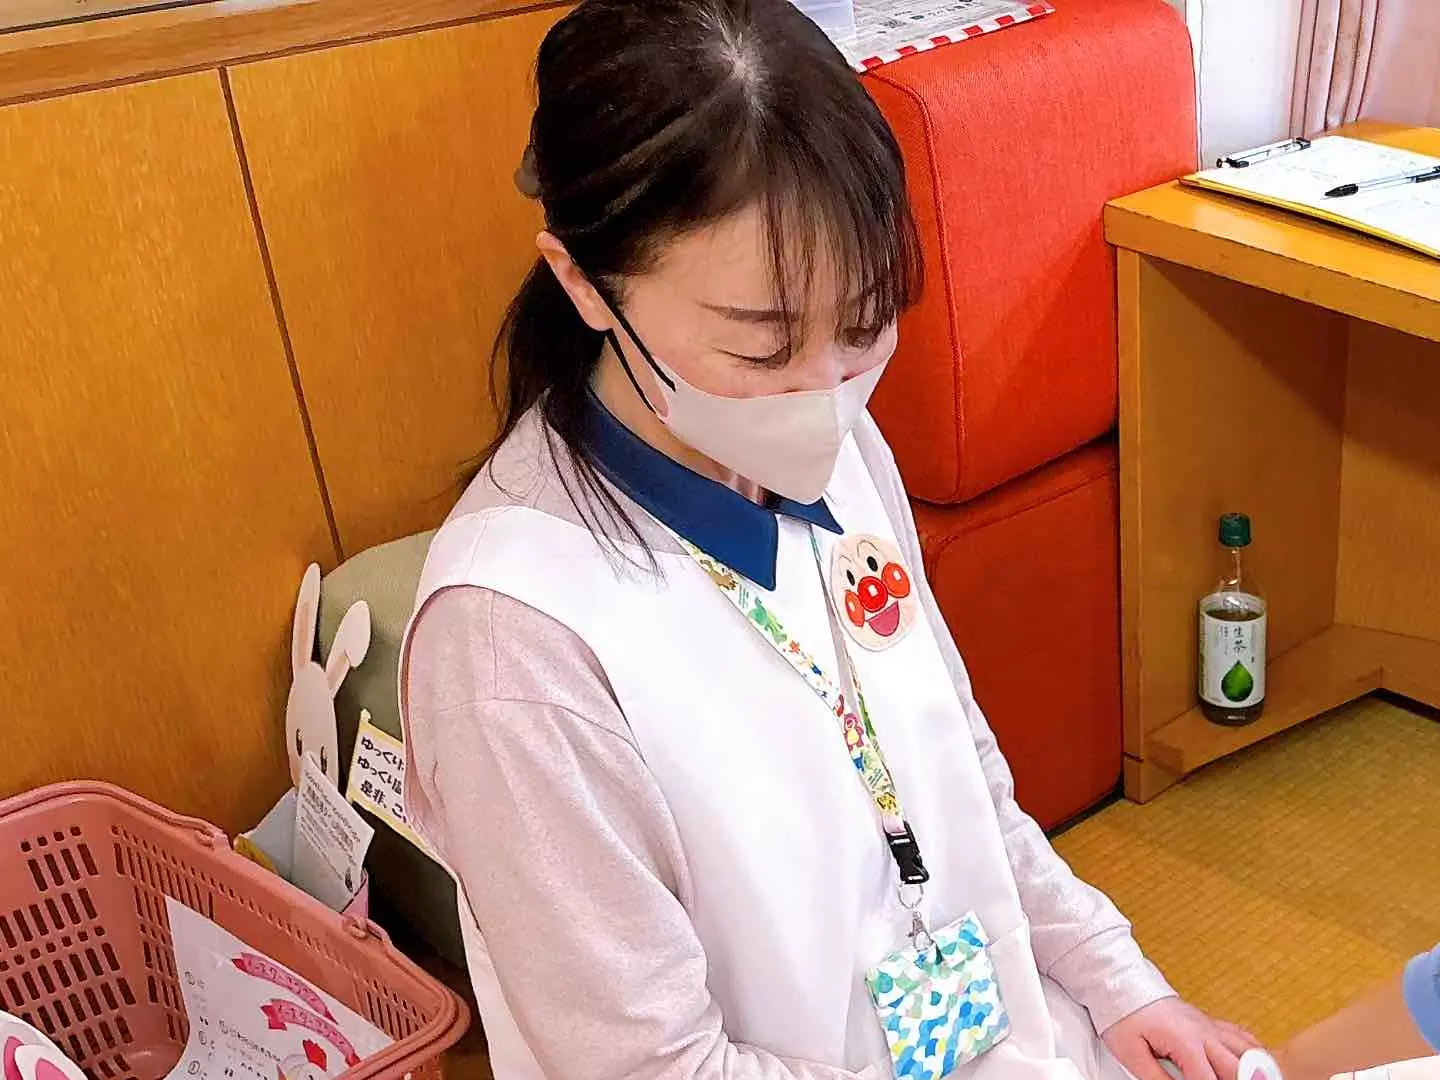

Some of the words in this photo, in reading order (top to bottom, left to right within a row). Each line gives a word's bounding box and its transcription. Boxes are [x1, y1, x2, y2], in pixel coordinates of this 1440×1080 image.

[361, 736, 405, 771] ゆっくり
[361, 780, 407, 823] 是非、こ
